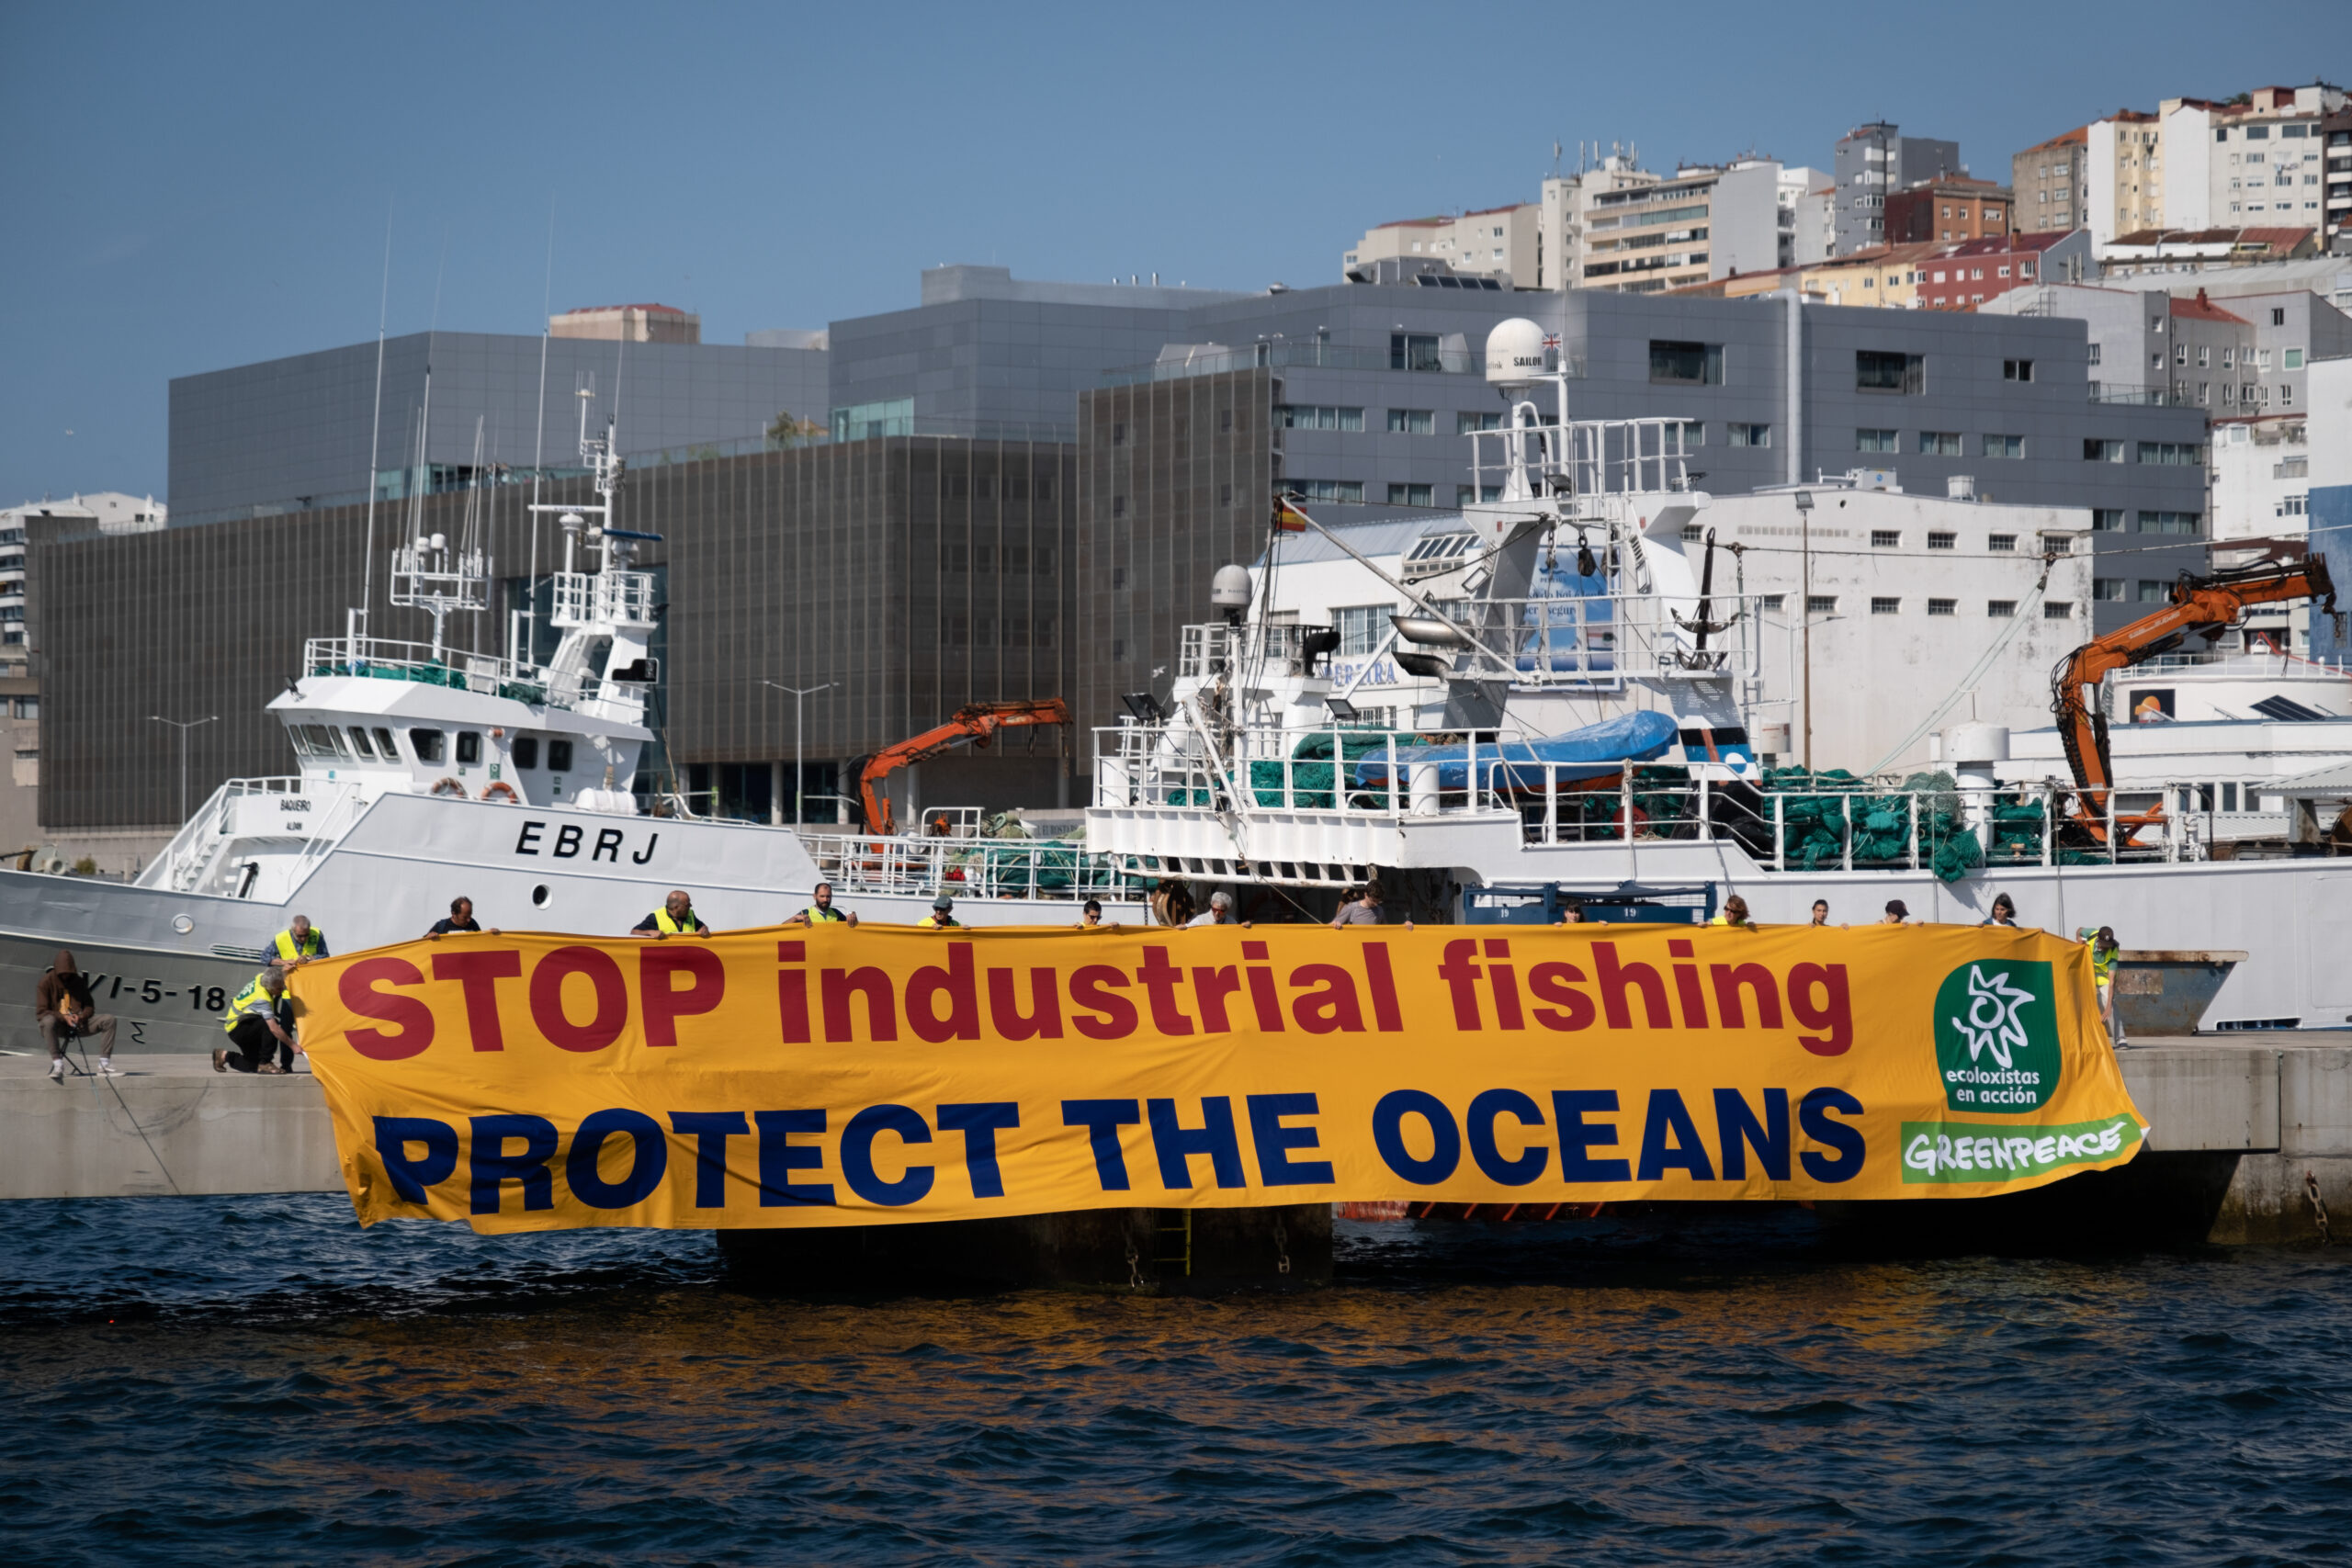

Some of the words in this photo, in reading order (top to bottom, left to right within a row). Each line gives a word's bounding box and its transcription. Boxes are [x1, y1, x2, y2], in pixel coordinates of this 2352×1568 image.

[1513, 356, 1543, 367] SAILOR
[515, 820, 659, 865] EBRJ
[1624, 908, 1637, 918] 19
[338, 945, 726, 1061] STOP
[777, 940, 1404, 1044] industrial
[1437, 938, 1854, 1057] fishing
[1946, 1066, 2041, 1085] ecoloxistas
[1957, 1089, 1975, 1102] en
[1980, 1086, 2037, 1104] acción
[372, 1103, 1020, 1215] PROTECT
[1061, 1093, 1334, 1190] THE
[1373, 1087, 1866, 1186] OCEANS
[1904, 1120, 2128, 1177] GREENPEACE
